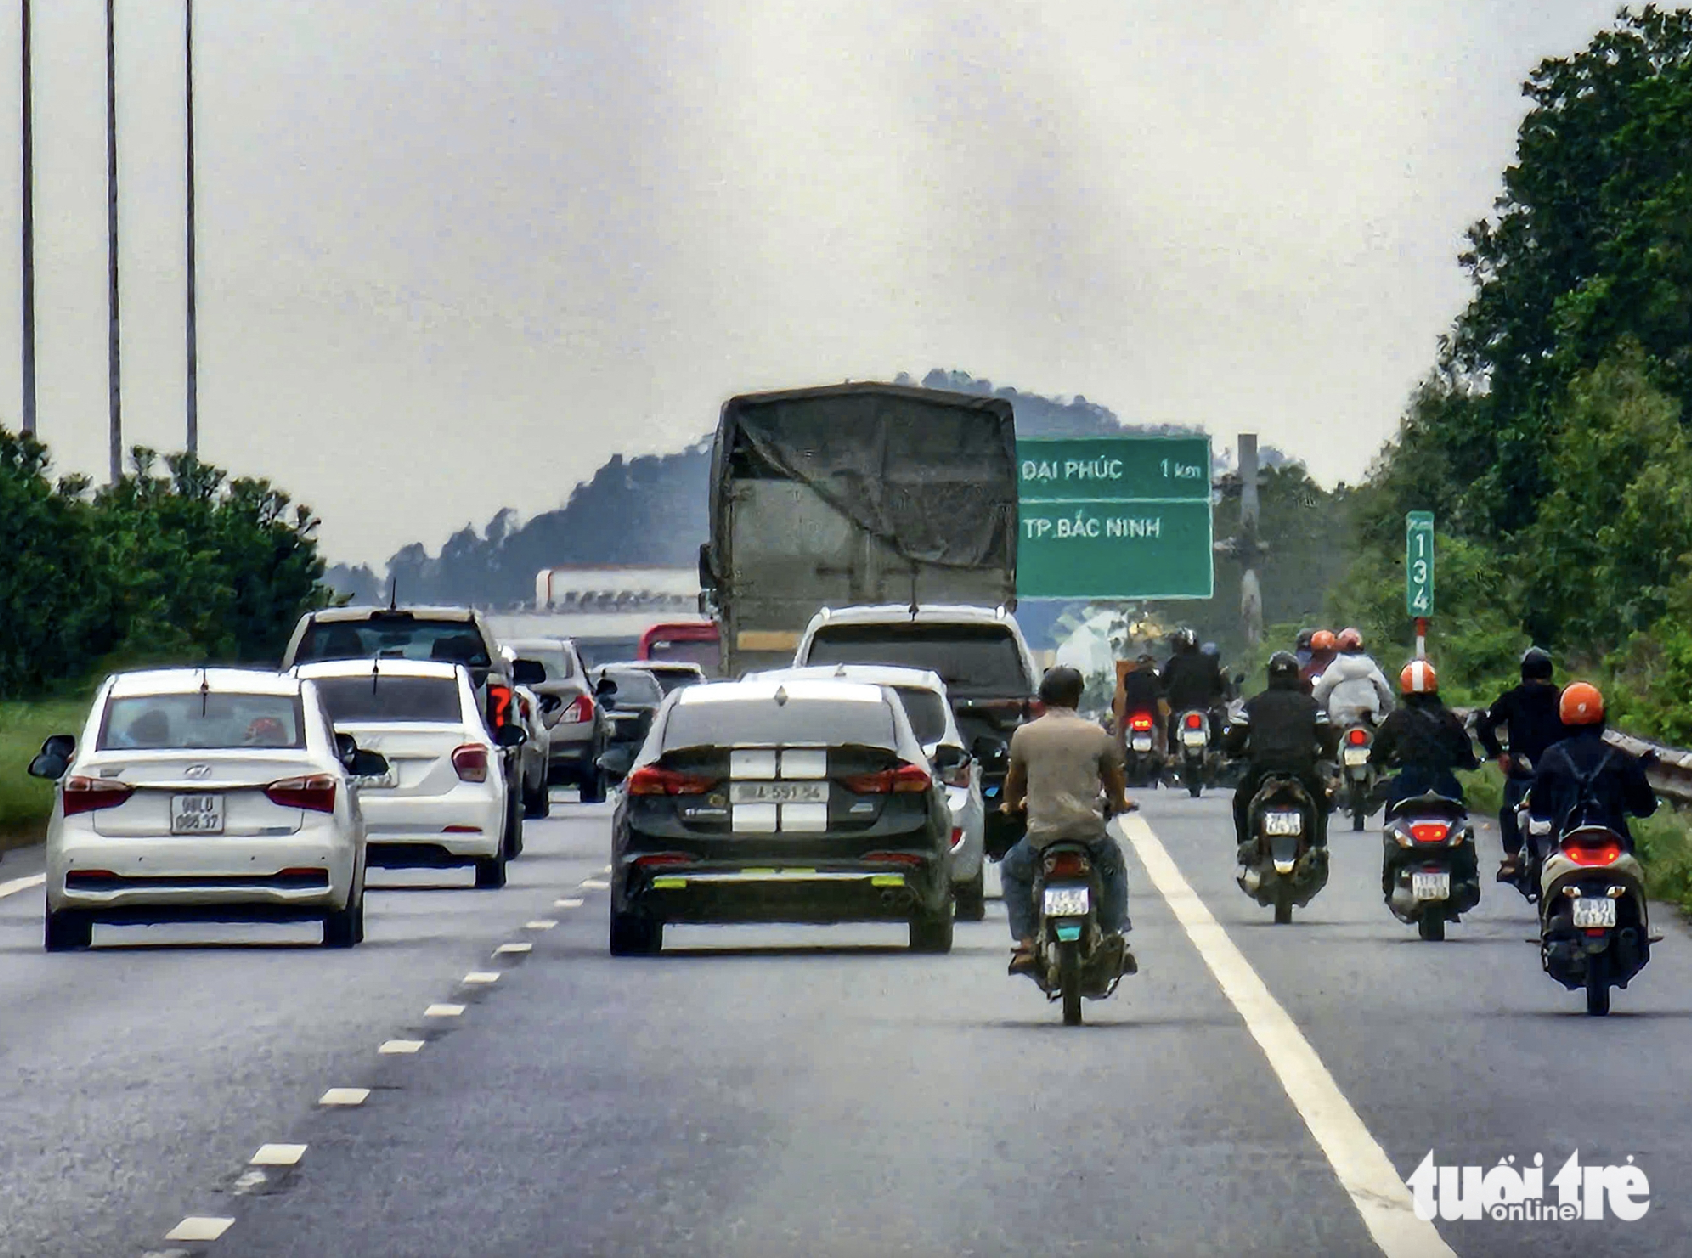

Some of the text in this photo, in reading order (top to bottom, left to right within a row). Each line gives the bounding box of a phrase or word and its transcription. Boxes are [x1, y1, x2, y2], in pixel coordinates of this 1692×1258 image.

[1021, 454, 1202, 483] ĐẠI PHÚC 1 km
[1106, 517, 1161, 538] NINH
[1411, 532, 1430, 612] 134
